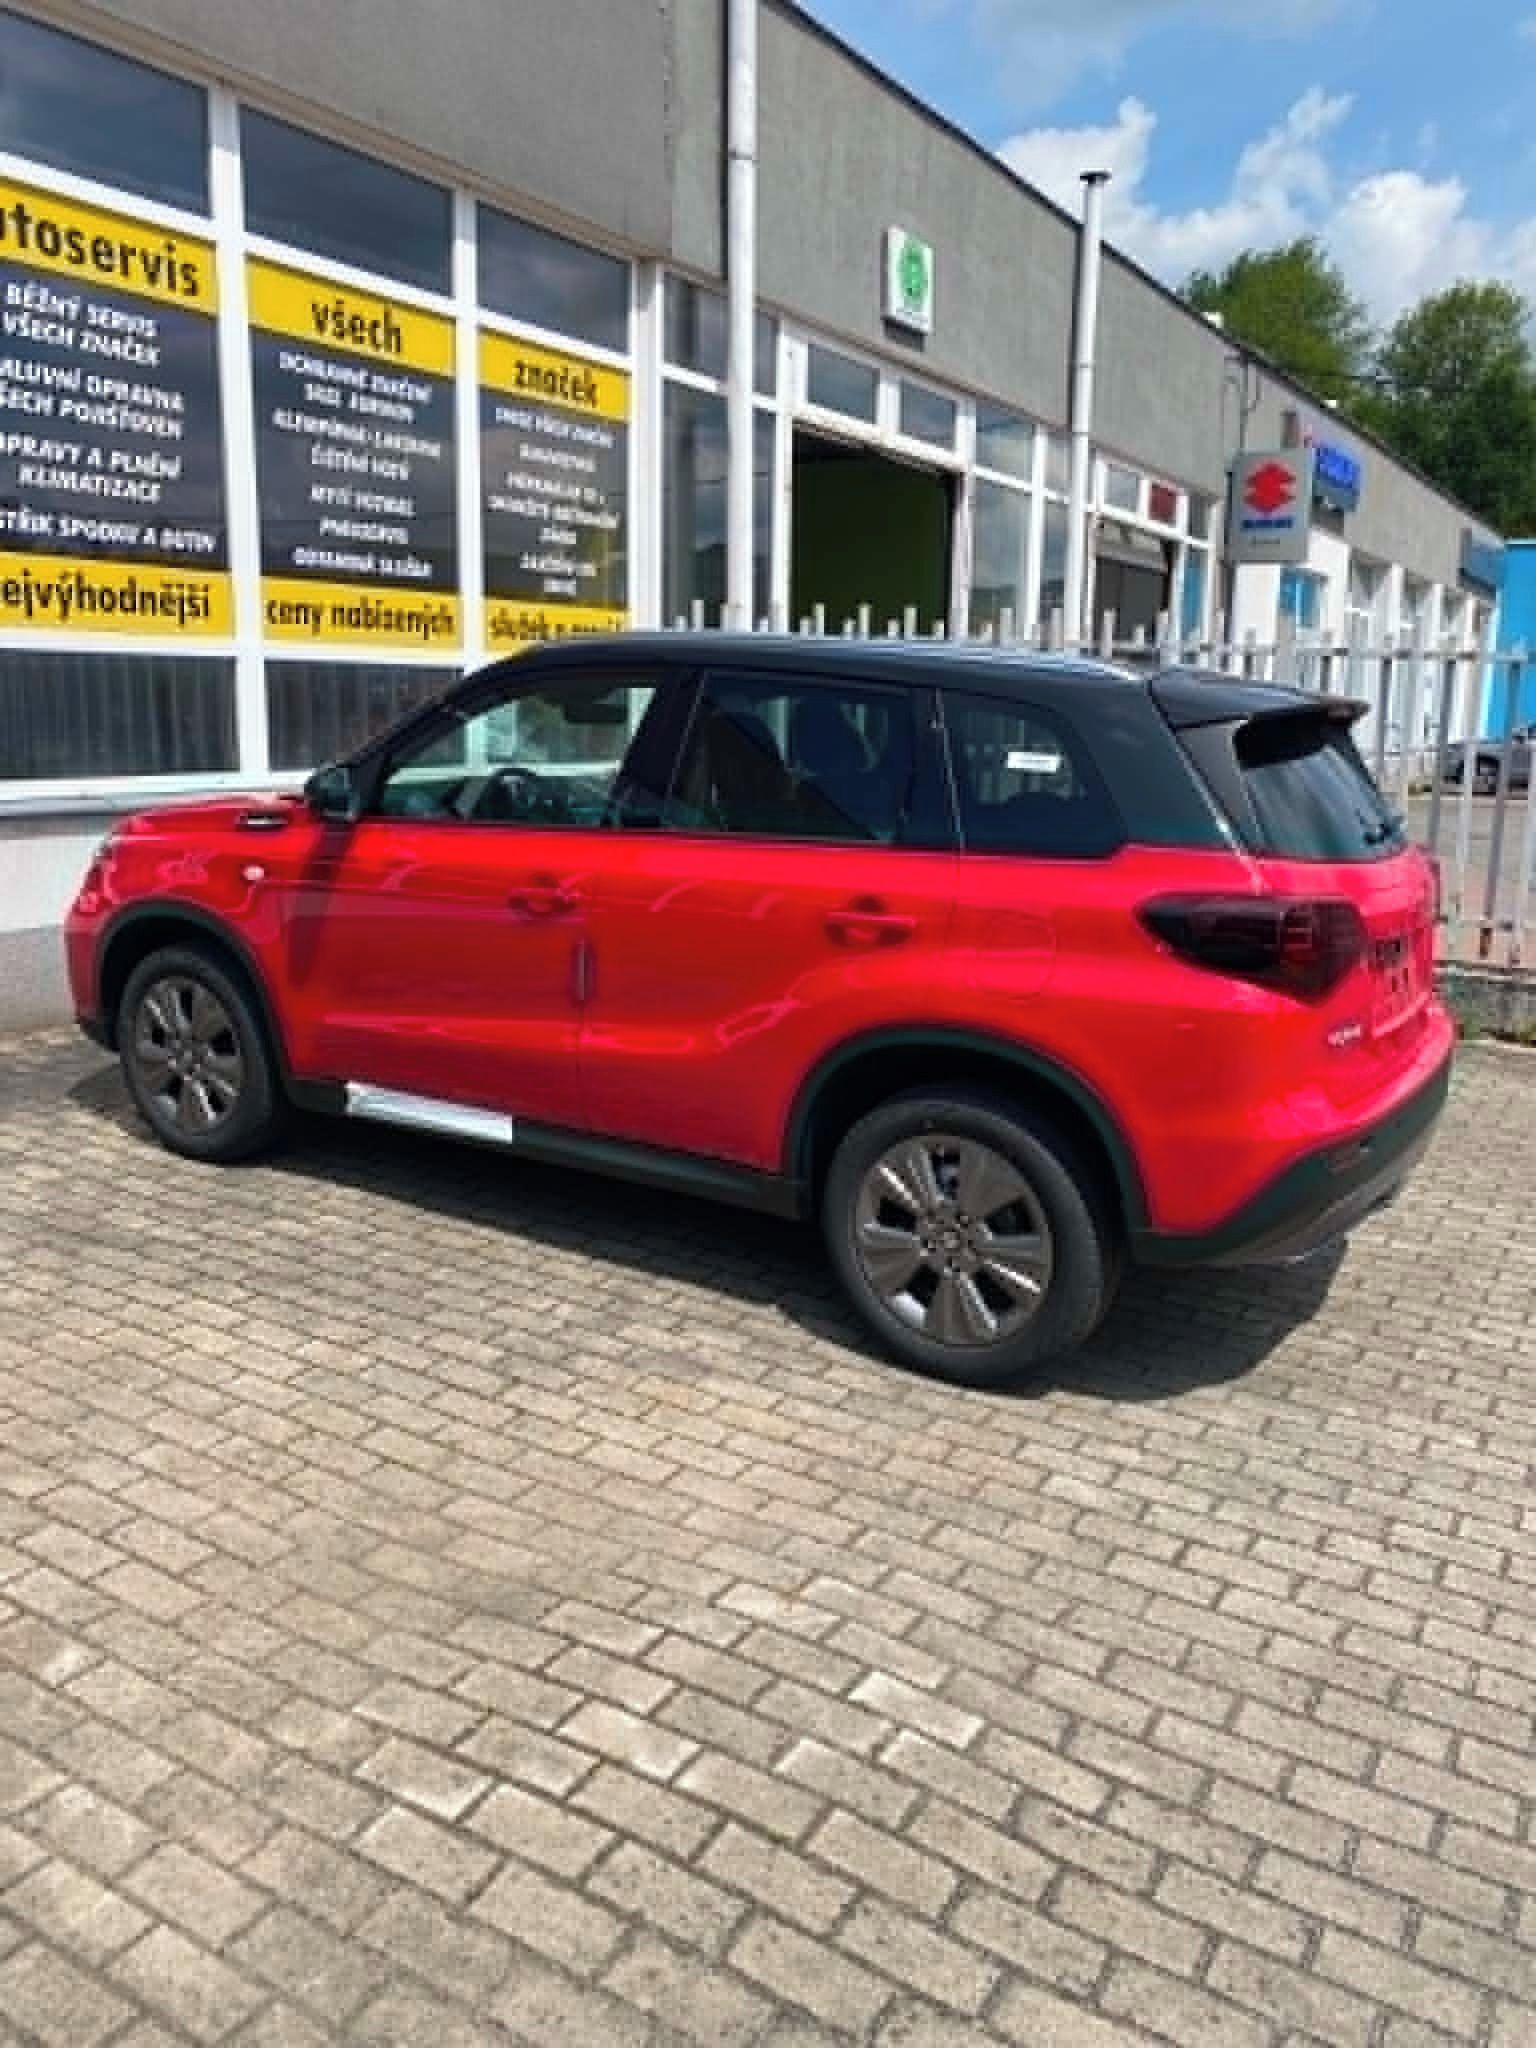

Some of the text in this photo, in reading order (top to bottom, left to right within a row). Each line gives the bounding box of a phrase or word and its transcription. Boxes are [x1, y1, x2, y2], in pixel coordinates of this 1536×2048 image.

[0, 203, 198, 296] toservis
[2, 311, 159, 367] VŠECH ZNAČEK
[87, 304, 158, 338] SERVIS
[311, 299, 401, 353] všech
[87, 448, 101, 467] A
[143, 527, 156, 545] A
